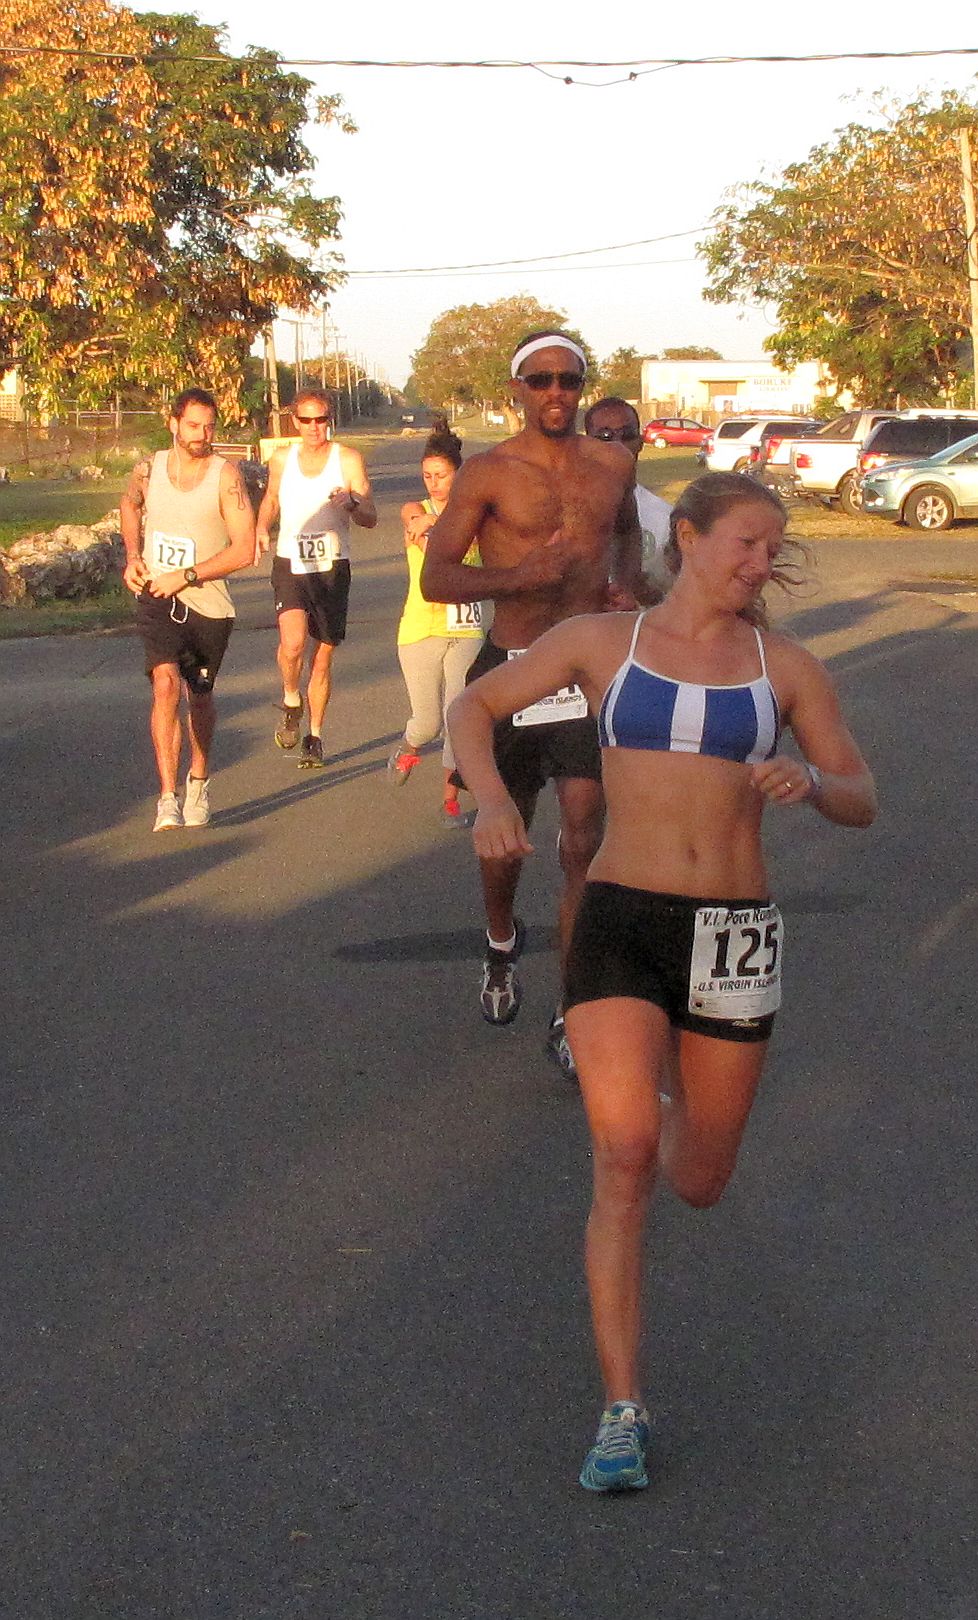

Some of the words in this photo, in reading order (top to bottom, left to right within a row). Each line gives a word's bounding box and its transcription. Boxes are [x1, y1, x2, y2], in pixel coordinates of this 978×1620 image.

[158, 543, 187, 567] 127
[298, 540, 326, 559] 129
[455, 602, 481, 624] 128
[710, 922, 778, 978] 125
[718, 979, 751, 991] VIRGIN
